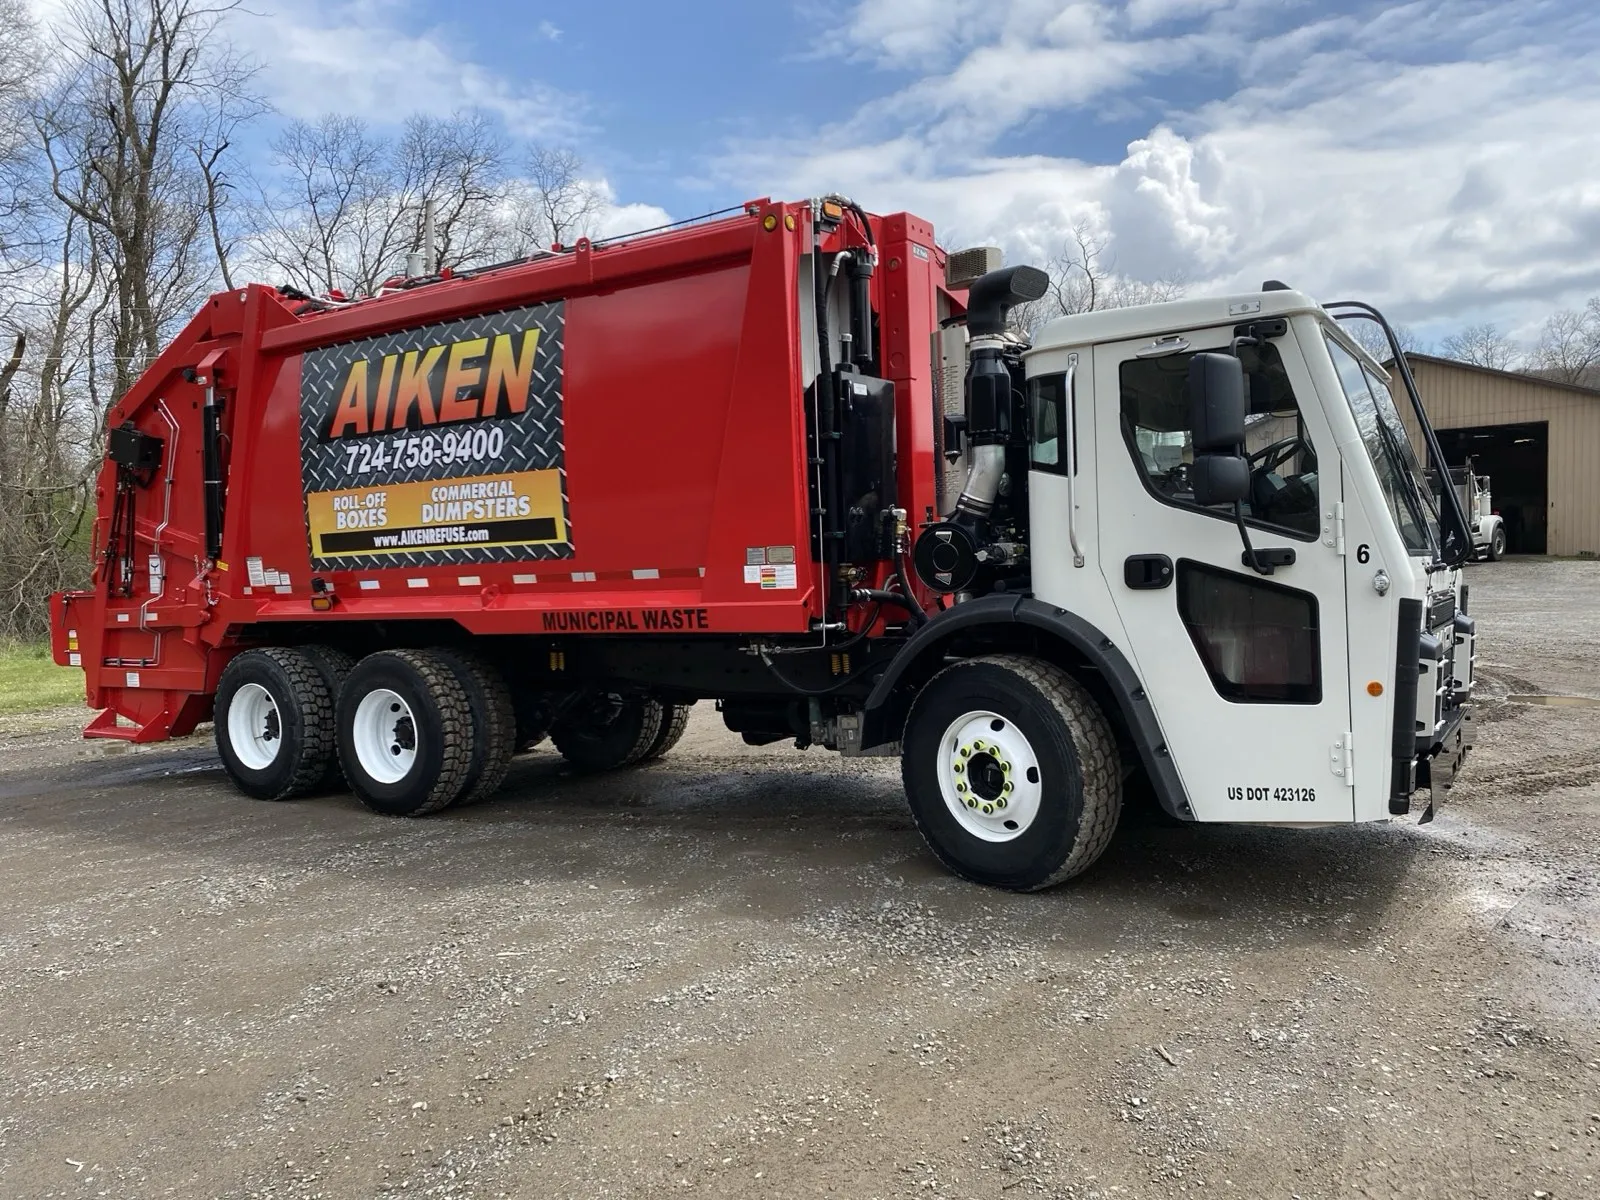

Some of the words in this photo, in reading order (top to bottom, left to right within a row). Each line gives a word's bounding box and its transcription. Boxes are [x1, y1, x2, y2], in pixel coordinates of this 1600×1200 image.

[329, 328, 541, 438] AIKEN
[345, 427, 504, 475] 724-758-9400
[431, 481, 515, 501] COMMERCIAL
[333, 493, 387, 511] ROLL-OFF
[421, 496, 531, 523] DUMPSTERS
[336, 508, 388, 529] BOXES
[373, 526, 489, 547] www.AIKENREFUSE.com
[1356, 543, 1371, 564] 6
[542, 611, 638, 631] MUNICIPAL
[642, 608, 709, 629] WASTE
[1227, 787, 1244, 801] US
[1246, 787, 1270, 801] DOT
[1273, 788, 1316, 802] 423126
